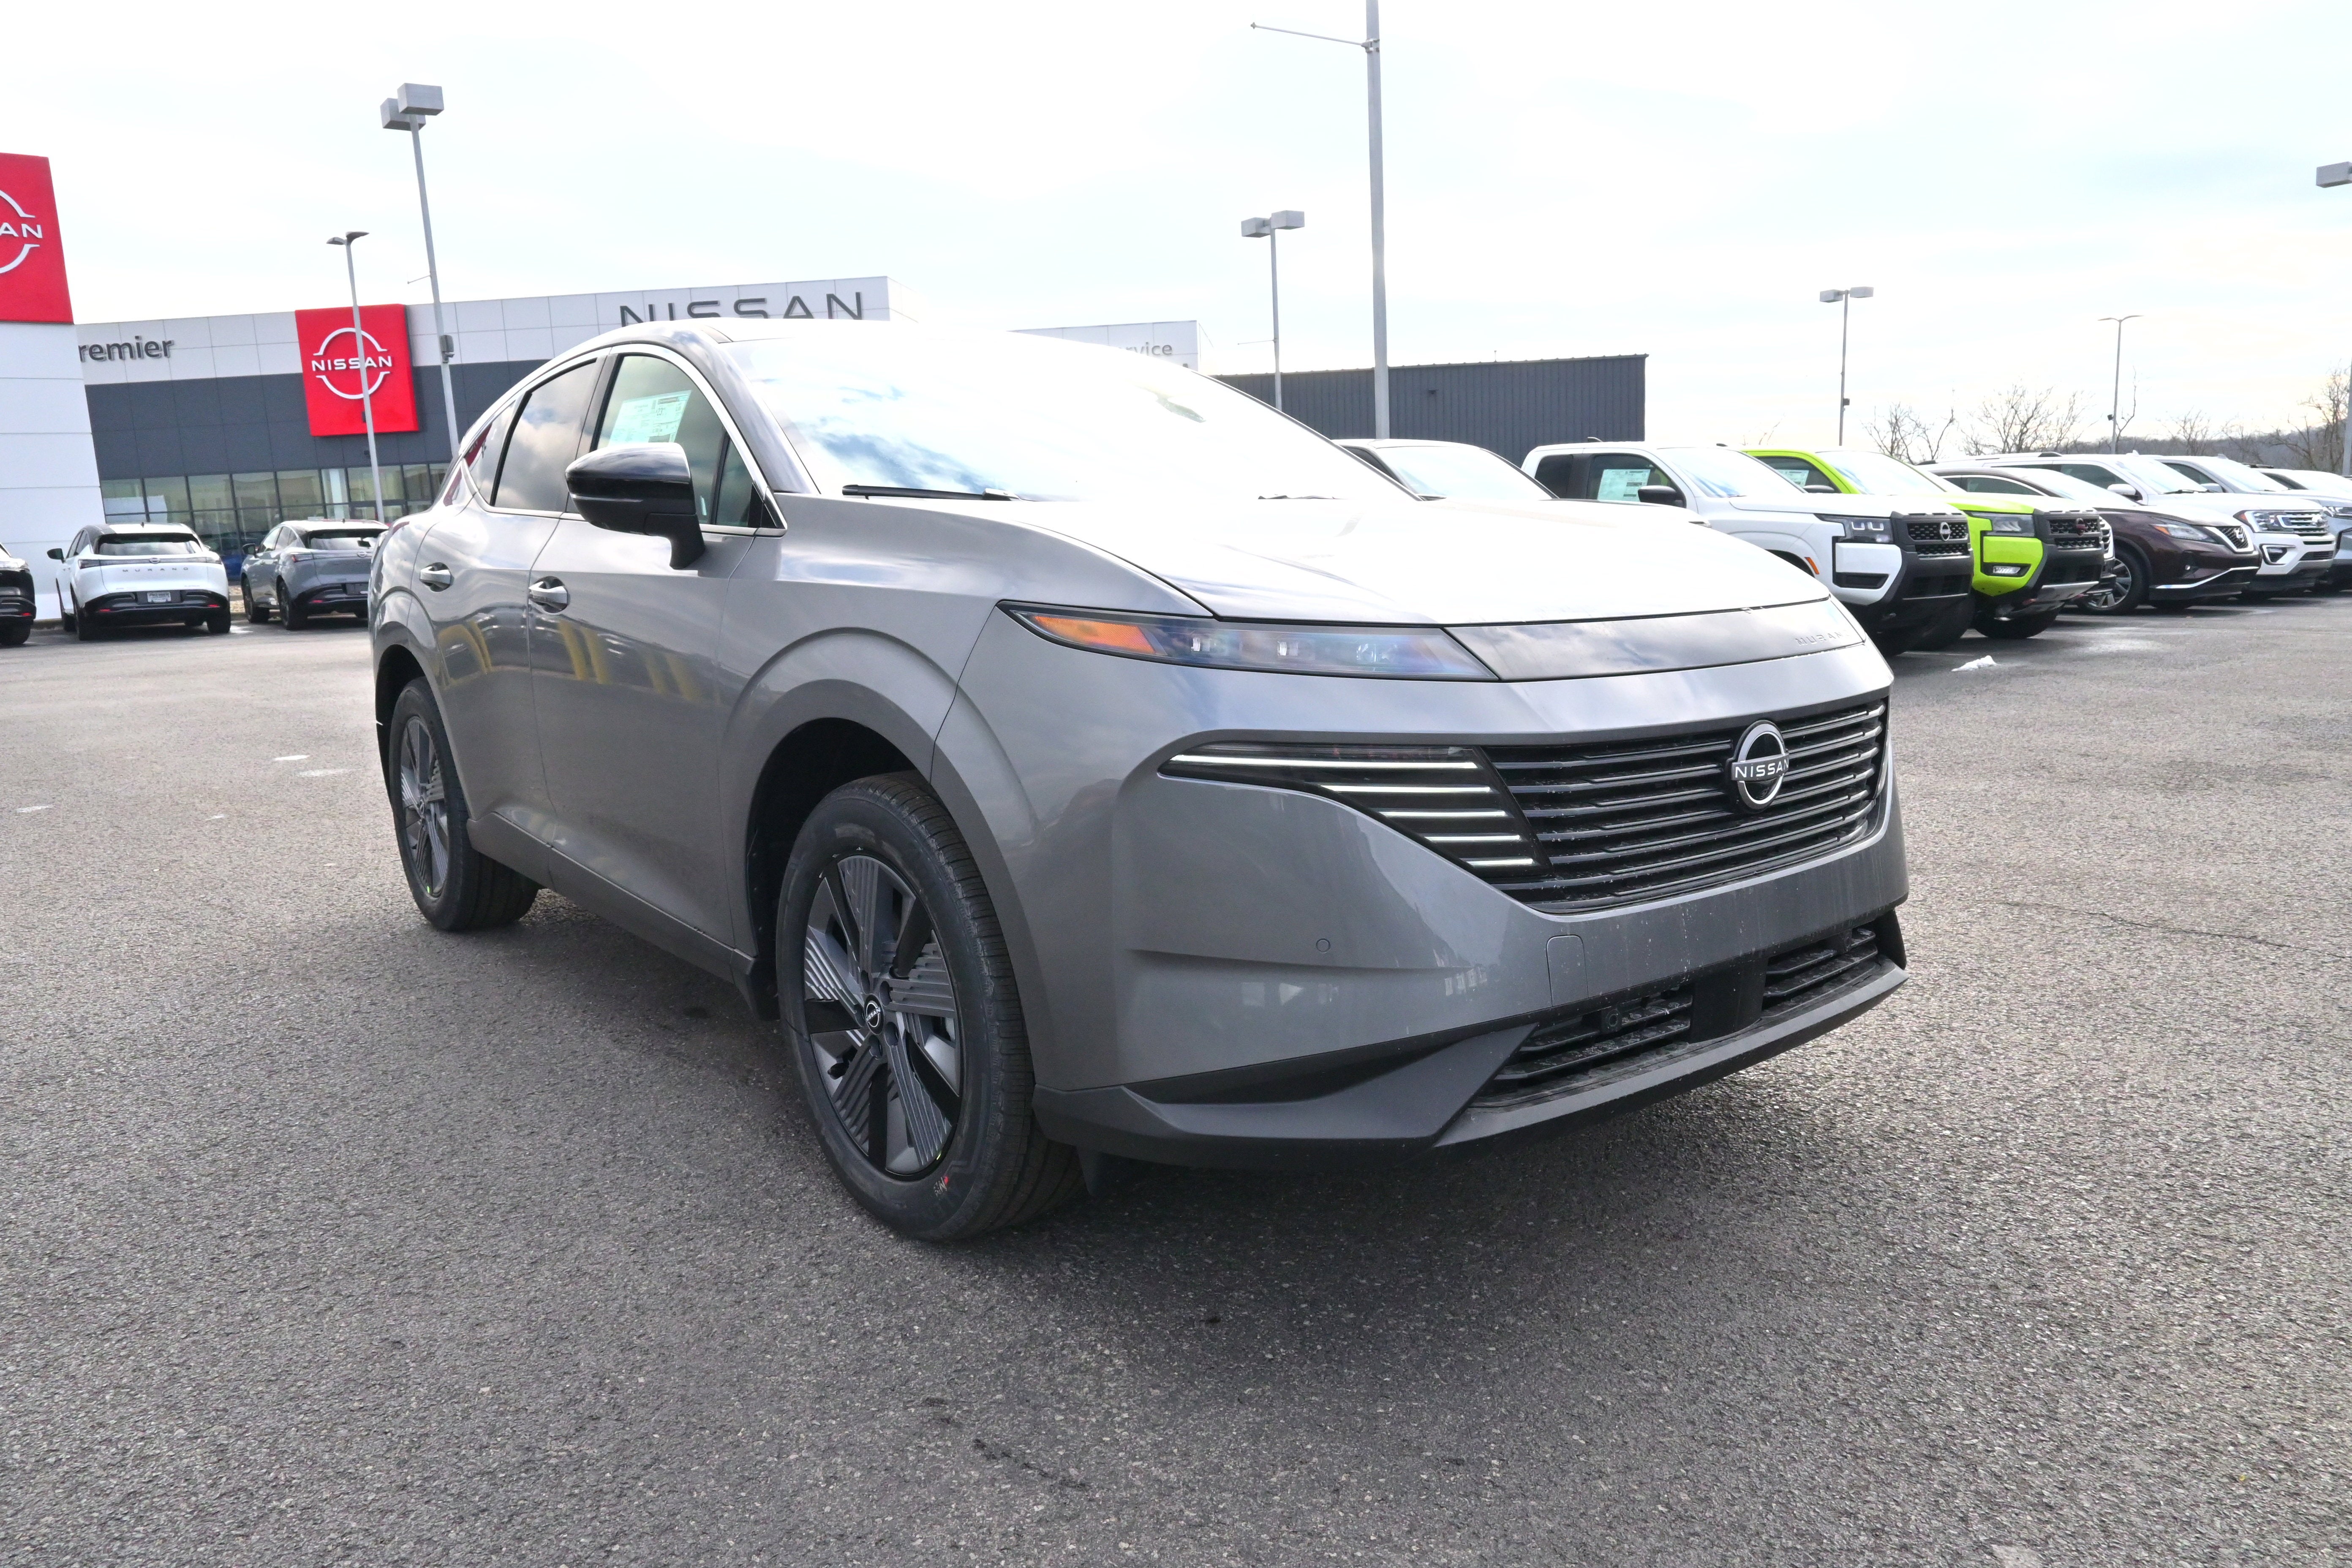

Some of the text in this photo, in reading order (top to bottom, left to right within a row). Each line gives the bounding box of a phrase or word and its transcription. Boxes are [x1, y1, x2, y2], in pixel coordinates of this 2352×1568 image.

[620, 291, 862, 327] NISSAN
[78, 335, 173, 362] remier
[311, 356, 392, 371] NISSAN
[1795, 630, 1849, 645] MURAN
[1735, 757, 1789, 778] NISSAN
